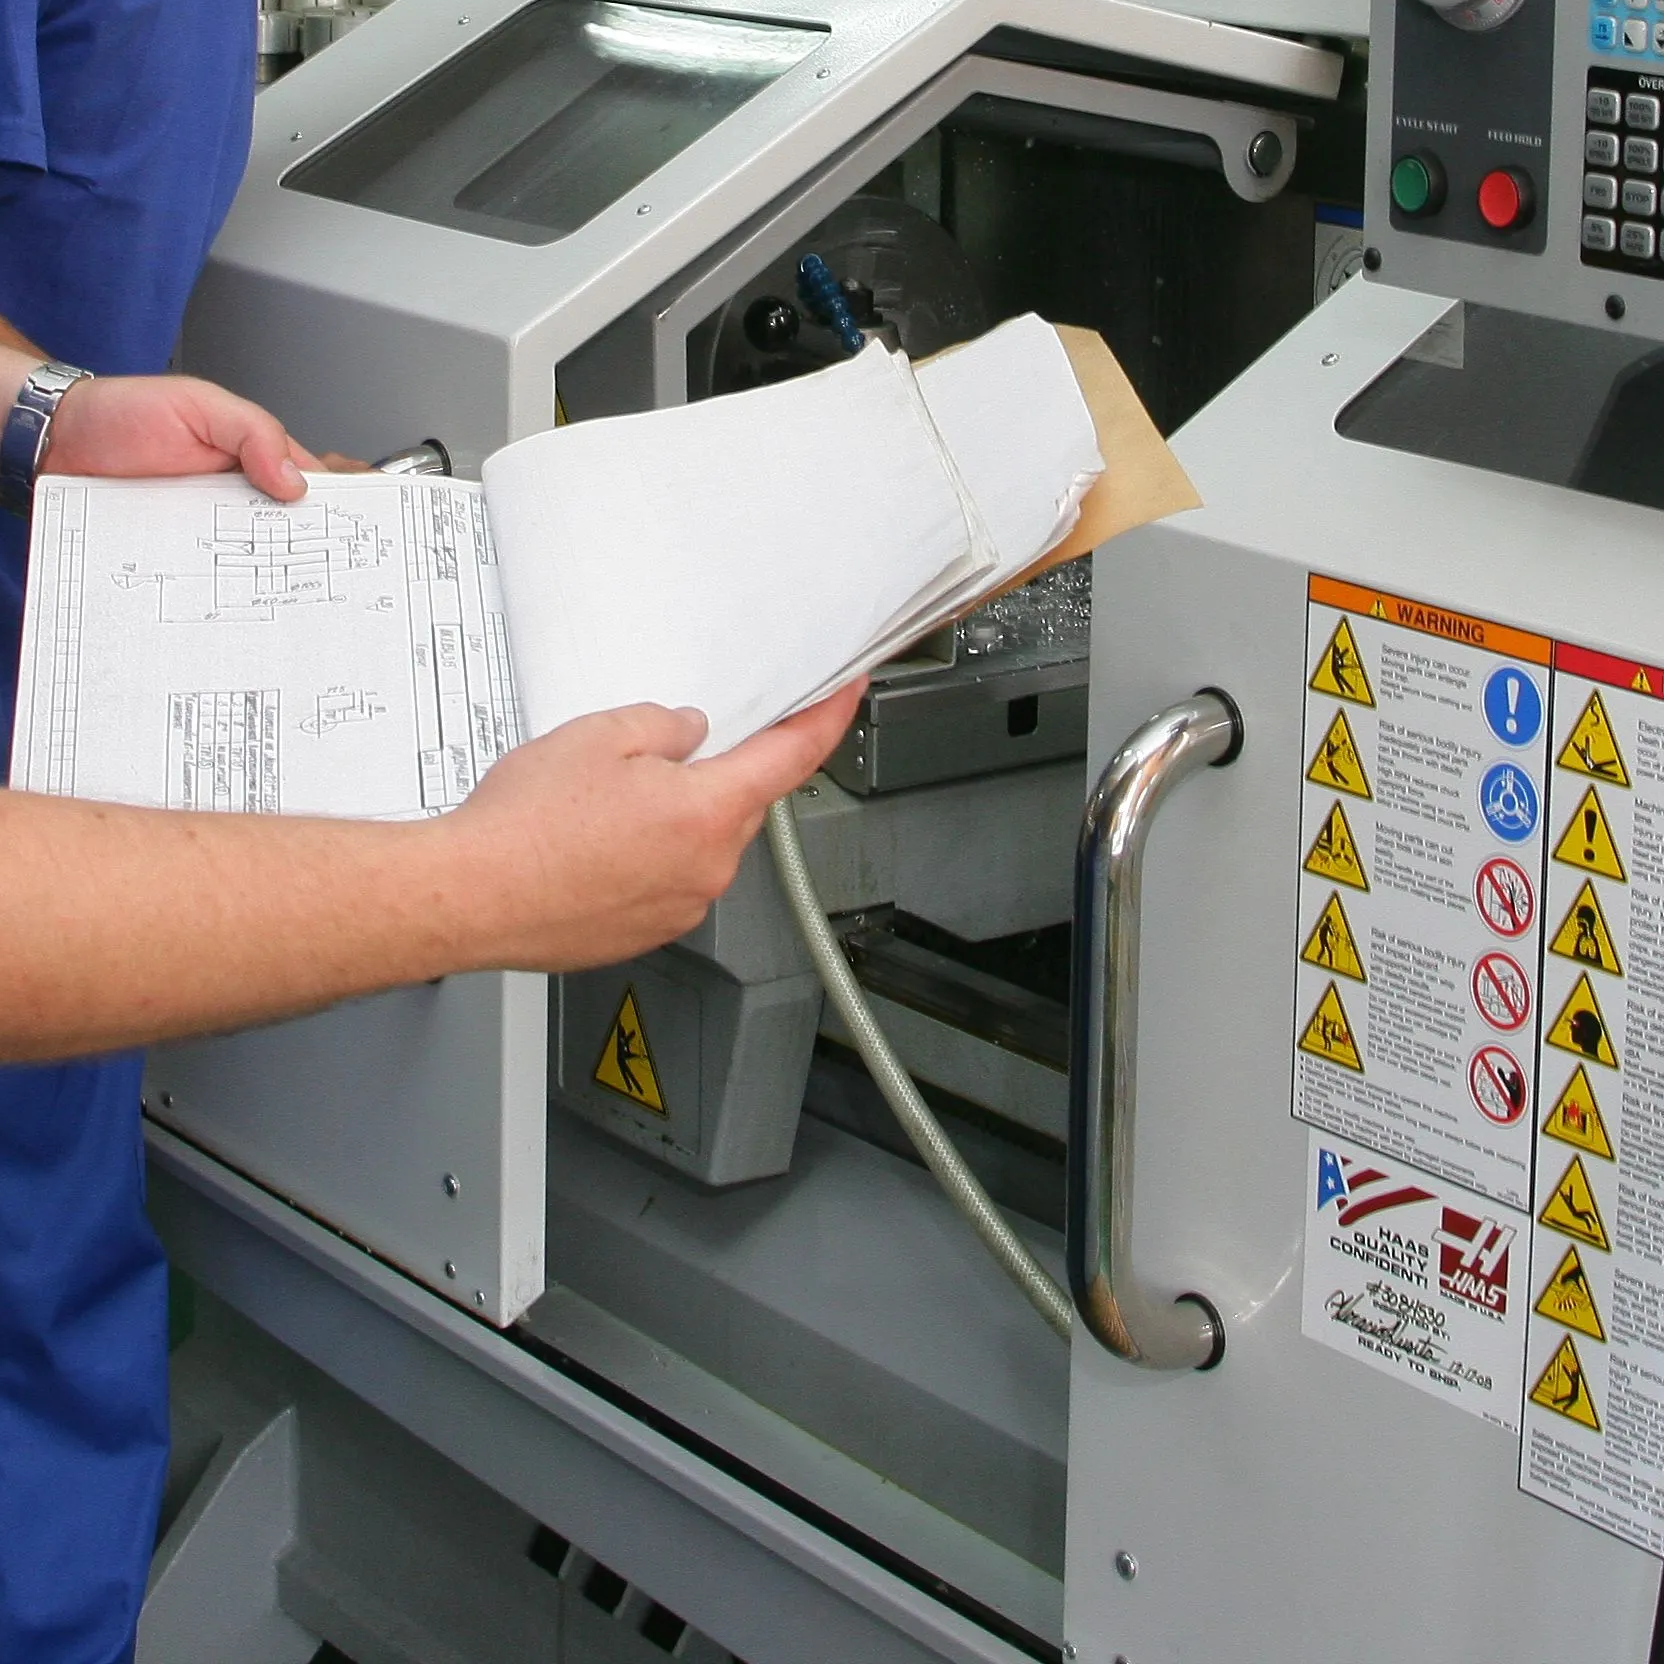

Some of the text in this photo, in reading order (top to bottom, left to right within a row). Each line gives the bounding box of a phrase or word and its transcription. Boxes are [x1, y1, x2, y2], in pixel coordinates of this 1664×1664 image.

[1396, 116, 1458, 134] CYCLE START
[1515, 135, 1542, 147] HOLD
[1396, 603, 1486, 645] WARNING
[1353, 1232, 1428, 1272] QUALITY
[1379, 1226, 1429, 1258] HAAS
[1330, 1236, 1428, 1290] CONFIDENT!
[1439, 1268, 1508, 1308] HAAS
[1358, 1336, 1402, 1364] READY
[1408, 1358, 1426, 1374] TO
